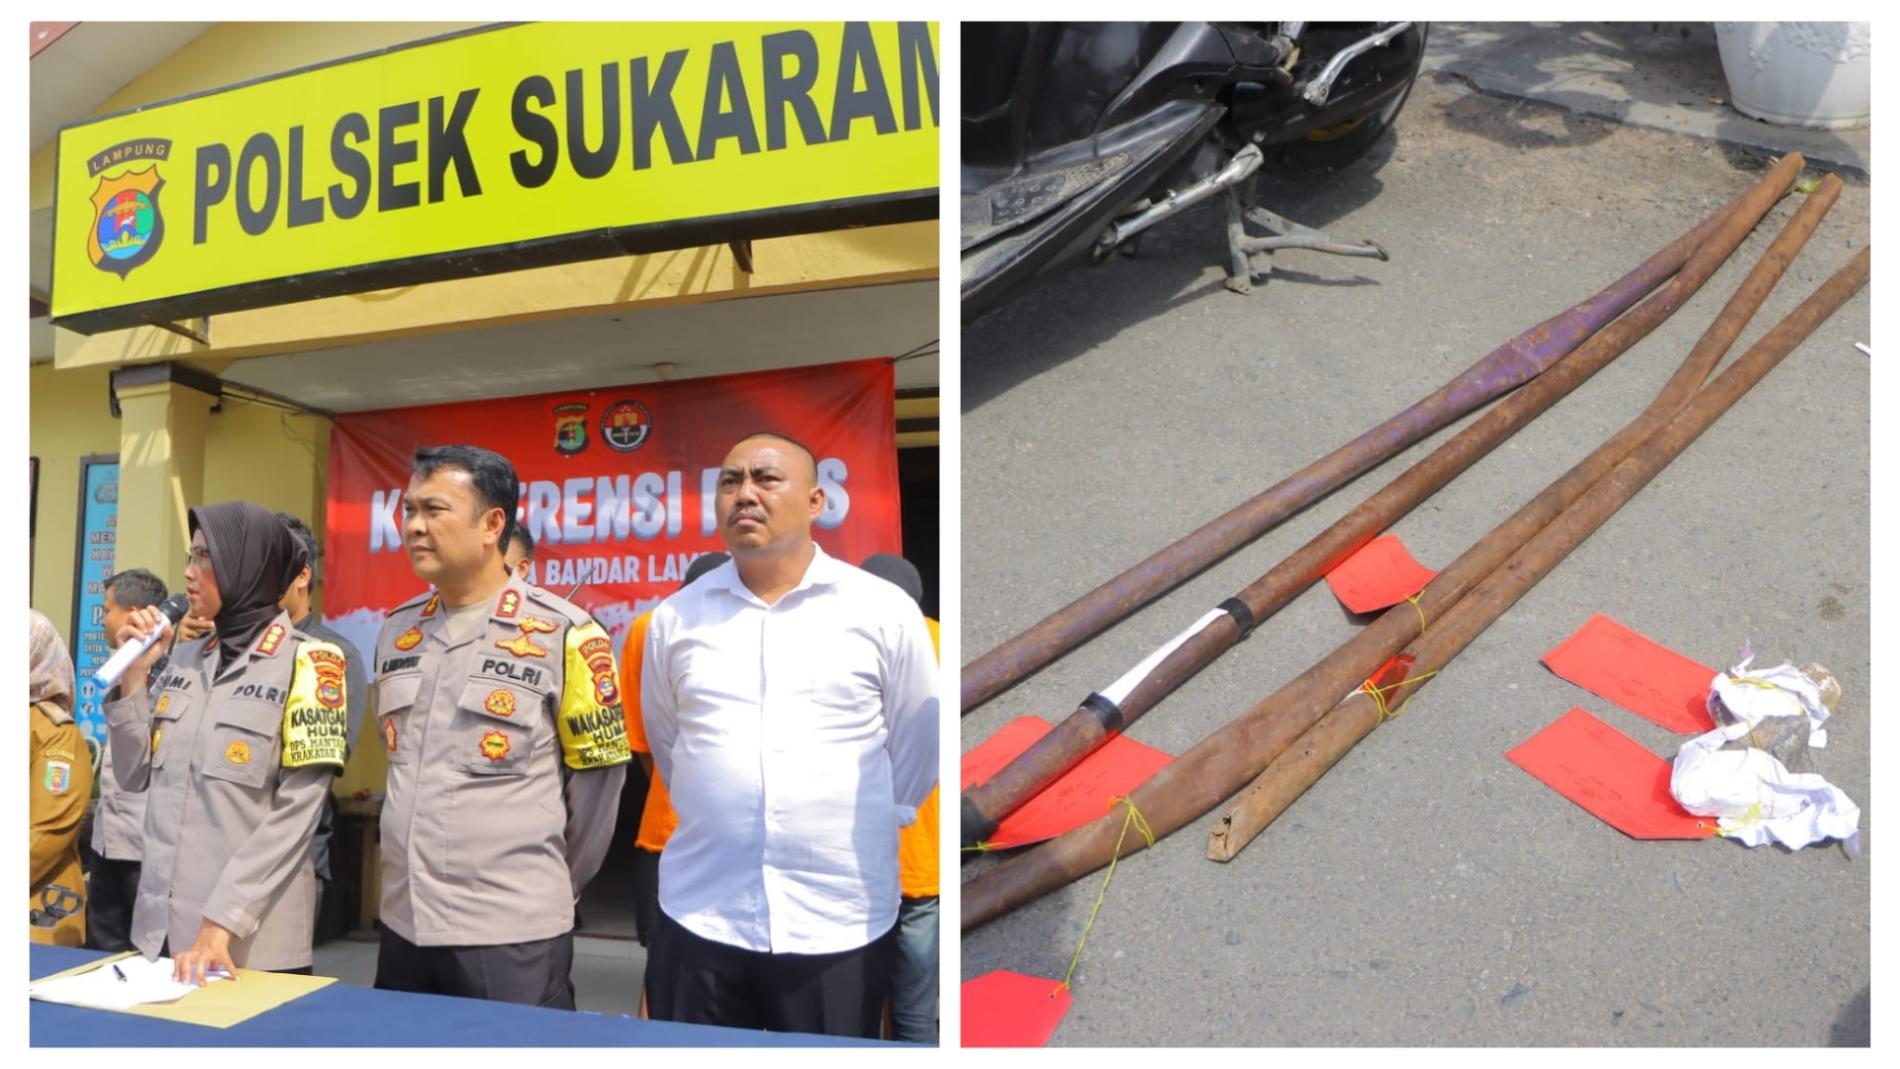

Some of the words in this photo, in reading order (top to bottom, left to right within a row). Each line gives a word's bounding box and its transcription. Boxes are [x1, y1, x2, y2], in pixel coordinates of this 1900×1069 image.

[92, 143, 166, 171] LAMPUNG
[193, 87, 483, 246] POLSEK
[545, 555, 640, 586] BANDAR
[482, 659, 541, 686] POLRI
[291, 708, 346, 728] KASATGA
[307, 726, 347, 738] HUMA
